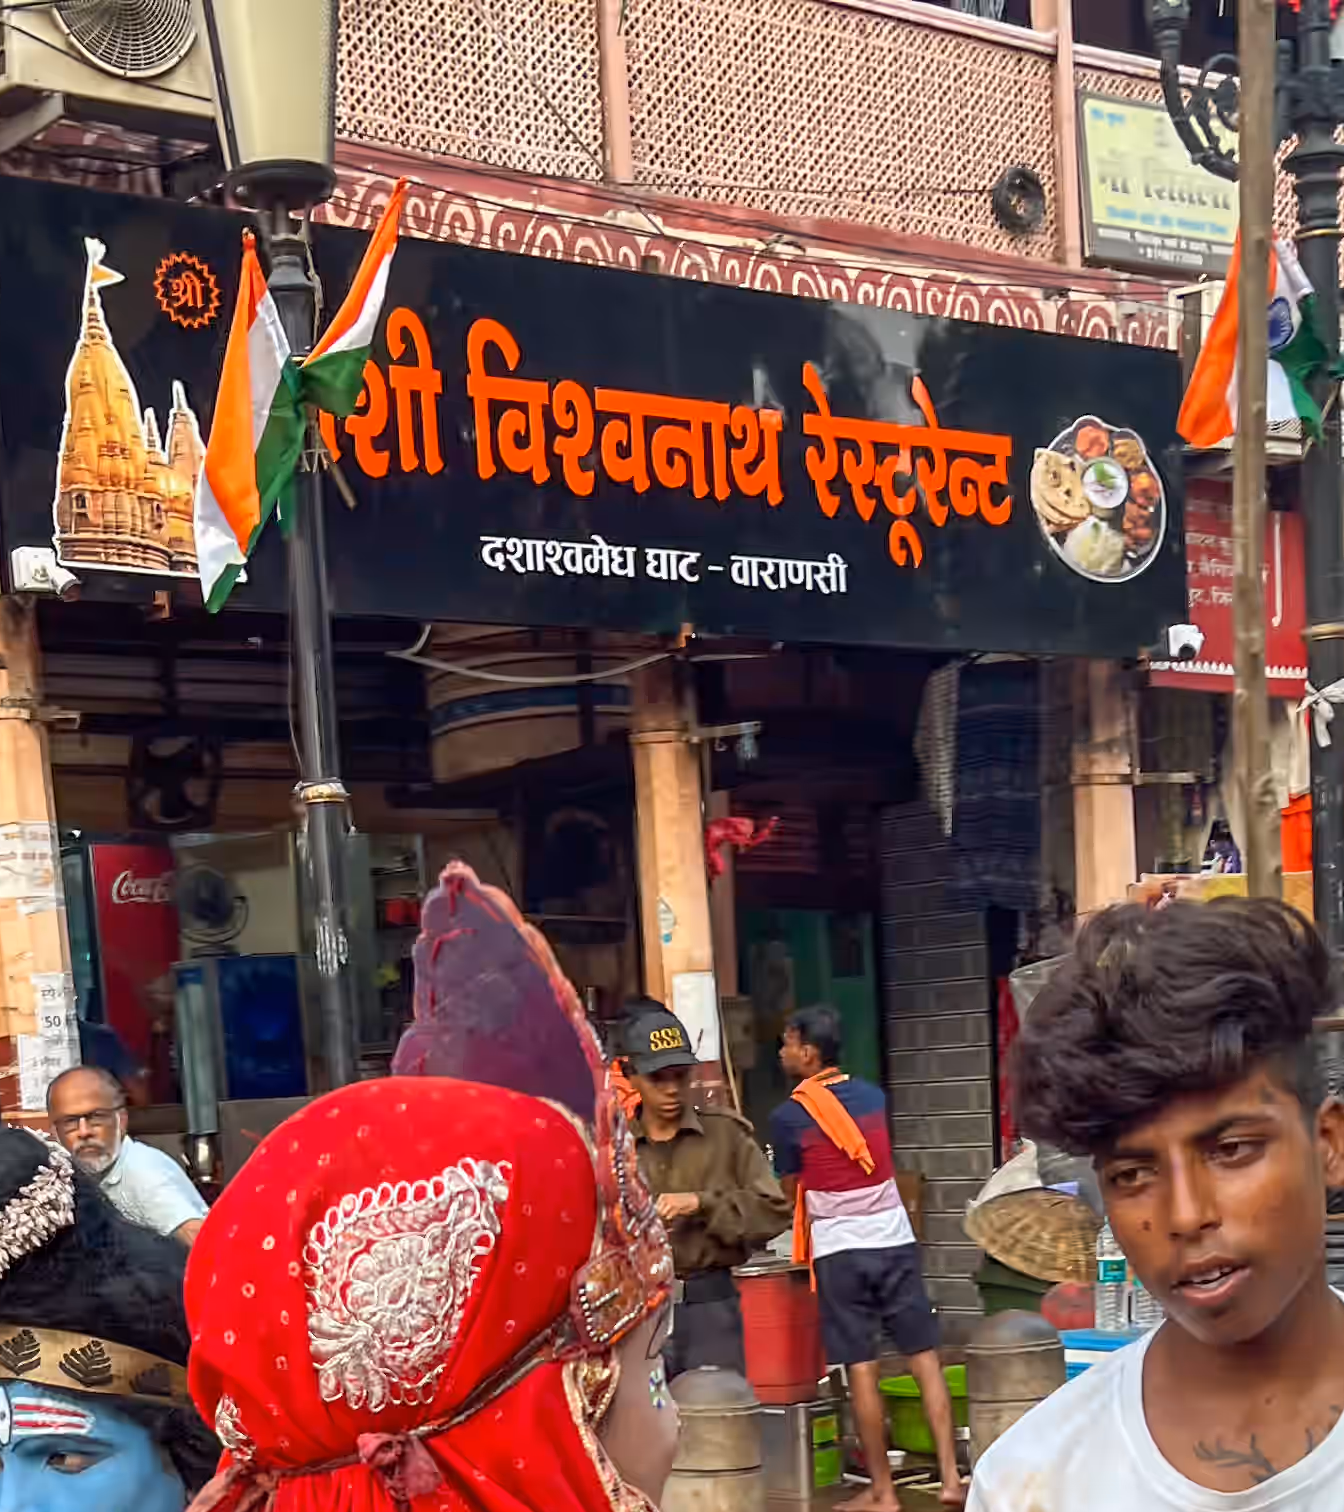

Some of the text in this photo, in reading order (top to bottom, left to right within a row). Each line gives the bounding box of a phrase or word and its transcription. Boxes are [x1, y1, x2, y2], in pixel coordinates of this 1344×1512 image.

[170, 271, 204, 308] श्री
[466, 318, 783, 506] विश्वनाथ
[480, 534, 636, 577] दशाश्वमेध
[646, 548, 701, 583] घाट
[730, 553, 848, 594] वाराणसी
